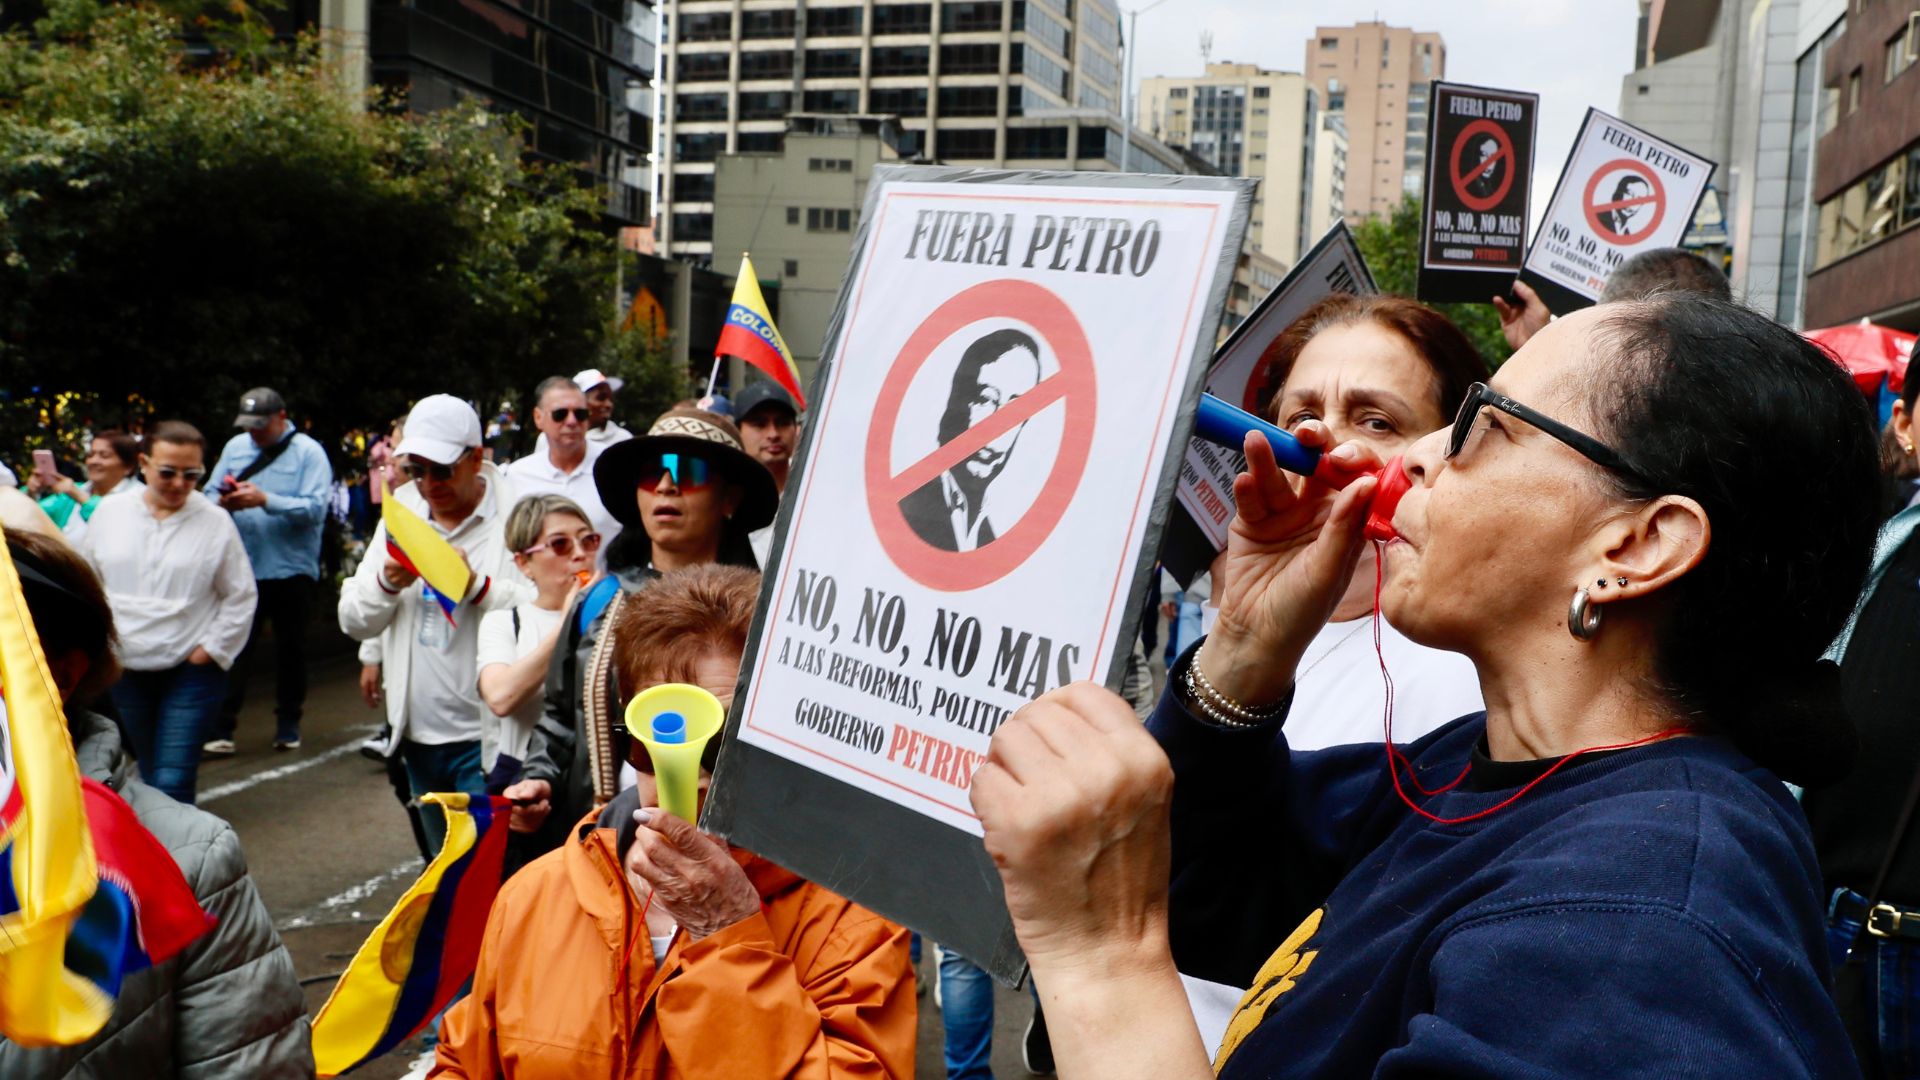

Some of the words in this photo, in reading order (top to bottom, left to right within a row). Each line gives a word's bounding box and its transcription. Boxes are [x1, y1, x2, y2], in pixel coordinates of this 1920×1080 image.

[1449, 96, 1483, 117] FUERA
[1486, 100, 1522, 121] PETRO
[1602, 126, 1643, 157] FUERA
[1645, 146, 1690, 178] PETRO
[904, 209, 1017, 267] FUERA
[1022, 214, 1161, 277] PETRO
[1435, 210, 1454, 232] NO,
[1457, 212, 1477, 233] NO,
[1480, 214, 1496, 233] NO
[1498, 214, 1521, 234] MAS
[1548, 221, 1571, 247] NO,
[1575, 234, 1598, 260] NO,
[1602, 248, 1624, 267] NO
[1193, 479, 1229, 526] PETRISTA
[786, 569, 840, 645] NO,
[852, 587, 911, 666] NO,
[924, 608, 981, 678] NO
[988, 626, 1080, 700] MAS
[777, 637, 791, 666] A
[793, 642, 826, 676] LAS
[827, 652, 923, 716] REFORMAS,
[795, 697, 884, 755] GOBIERNO
[887, 723, 988, 790] PETRIS
